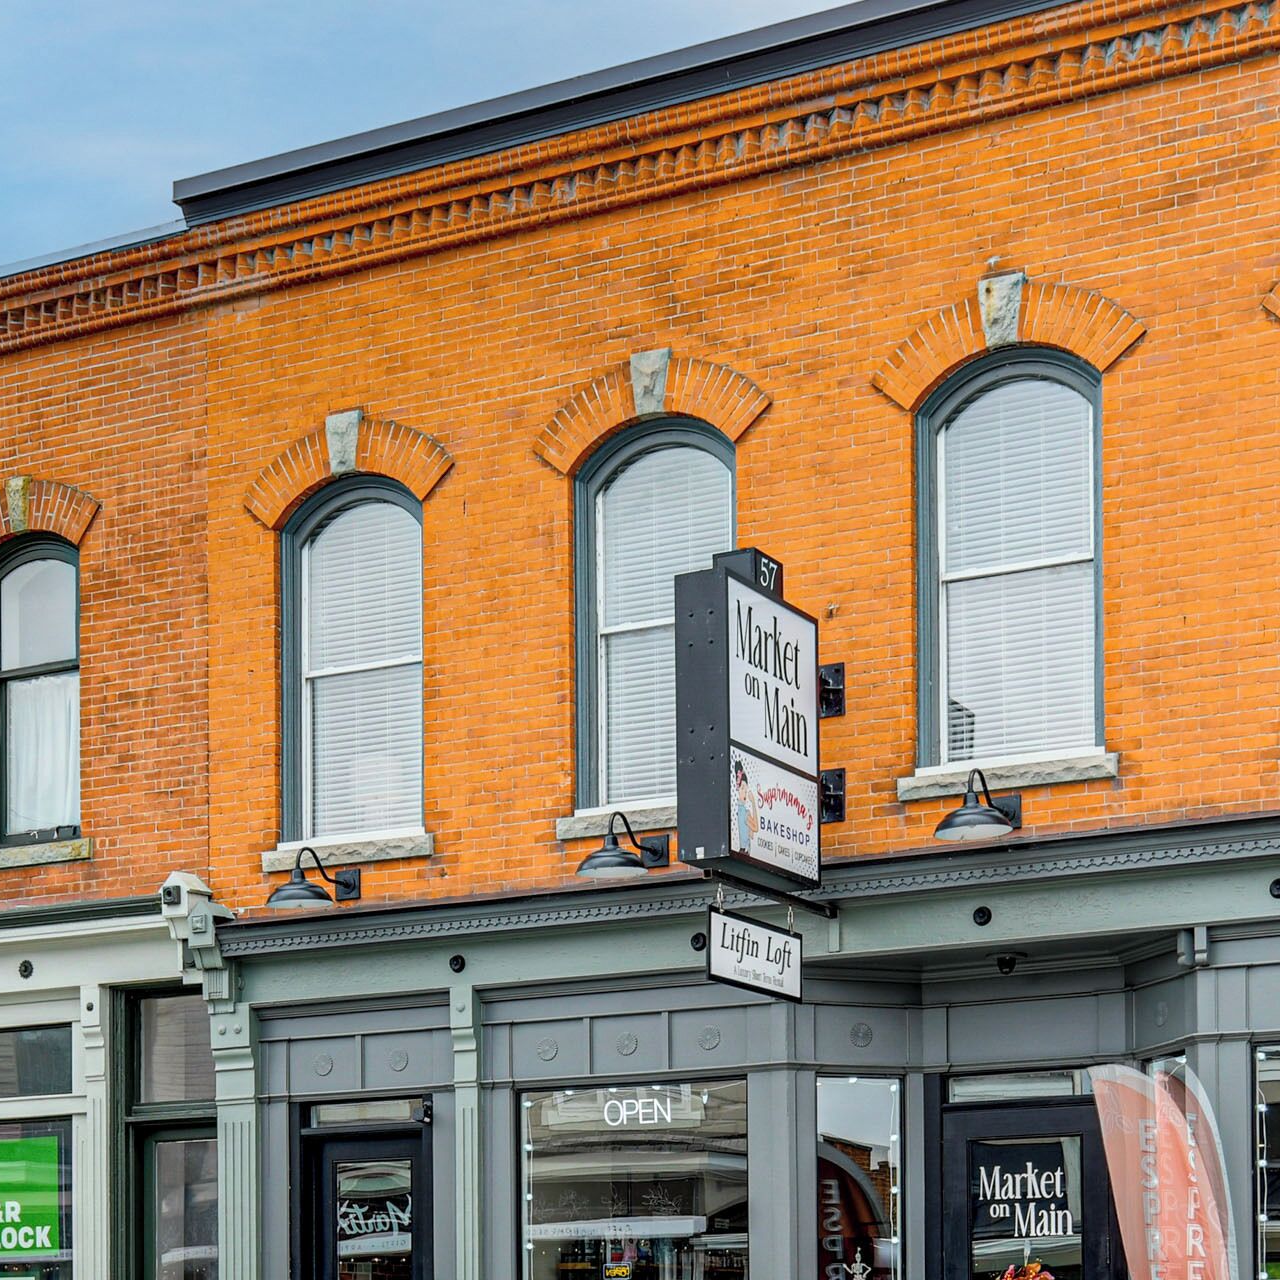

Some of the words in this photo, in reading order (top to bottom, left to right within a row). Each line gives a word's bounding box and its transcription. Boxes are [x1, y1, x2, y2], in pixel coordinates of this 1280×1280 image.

[760, 558, 777, 591] 57
[736, 599, 801, 691] Market
[745, 672, 761, 700] on
[763, 681, 809, 757] Main
[760, 816, 811, 847] BAKESHOP
[721, 922, 760, 964] Litfin
[766, 935, 793, 976] Loft
[604, 1097, 672, 1126] OPEN
[979, 1162, 1065, 1201] Market
[989, 1203, 1011, 1218] on
[1014, 1201, 1074, 1237] Main
